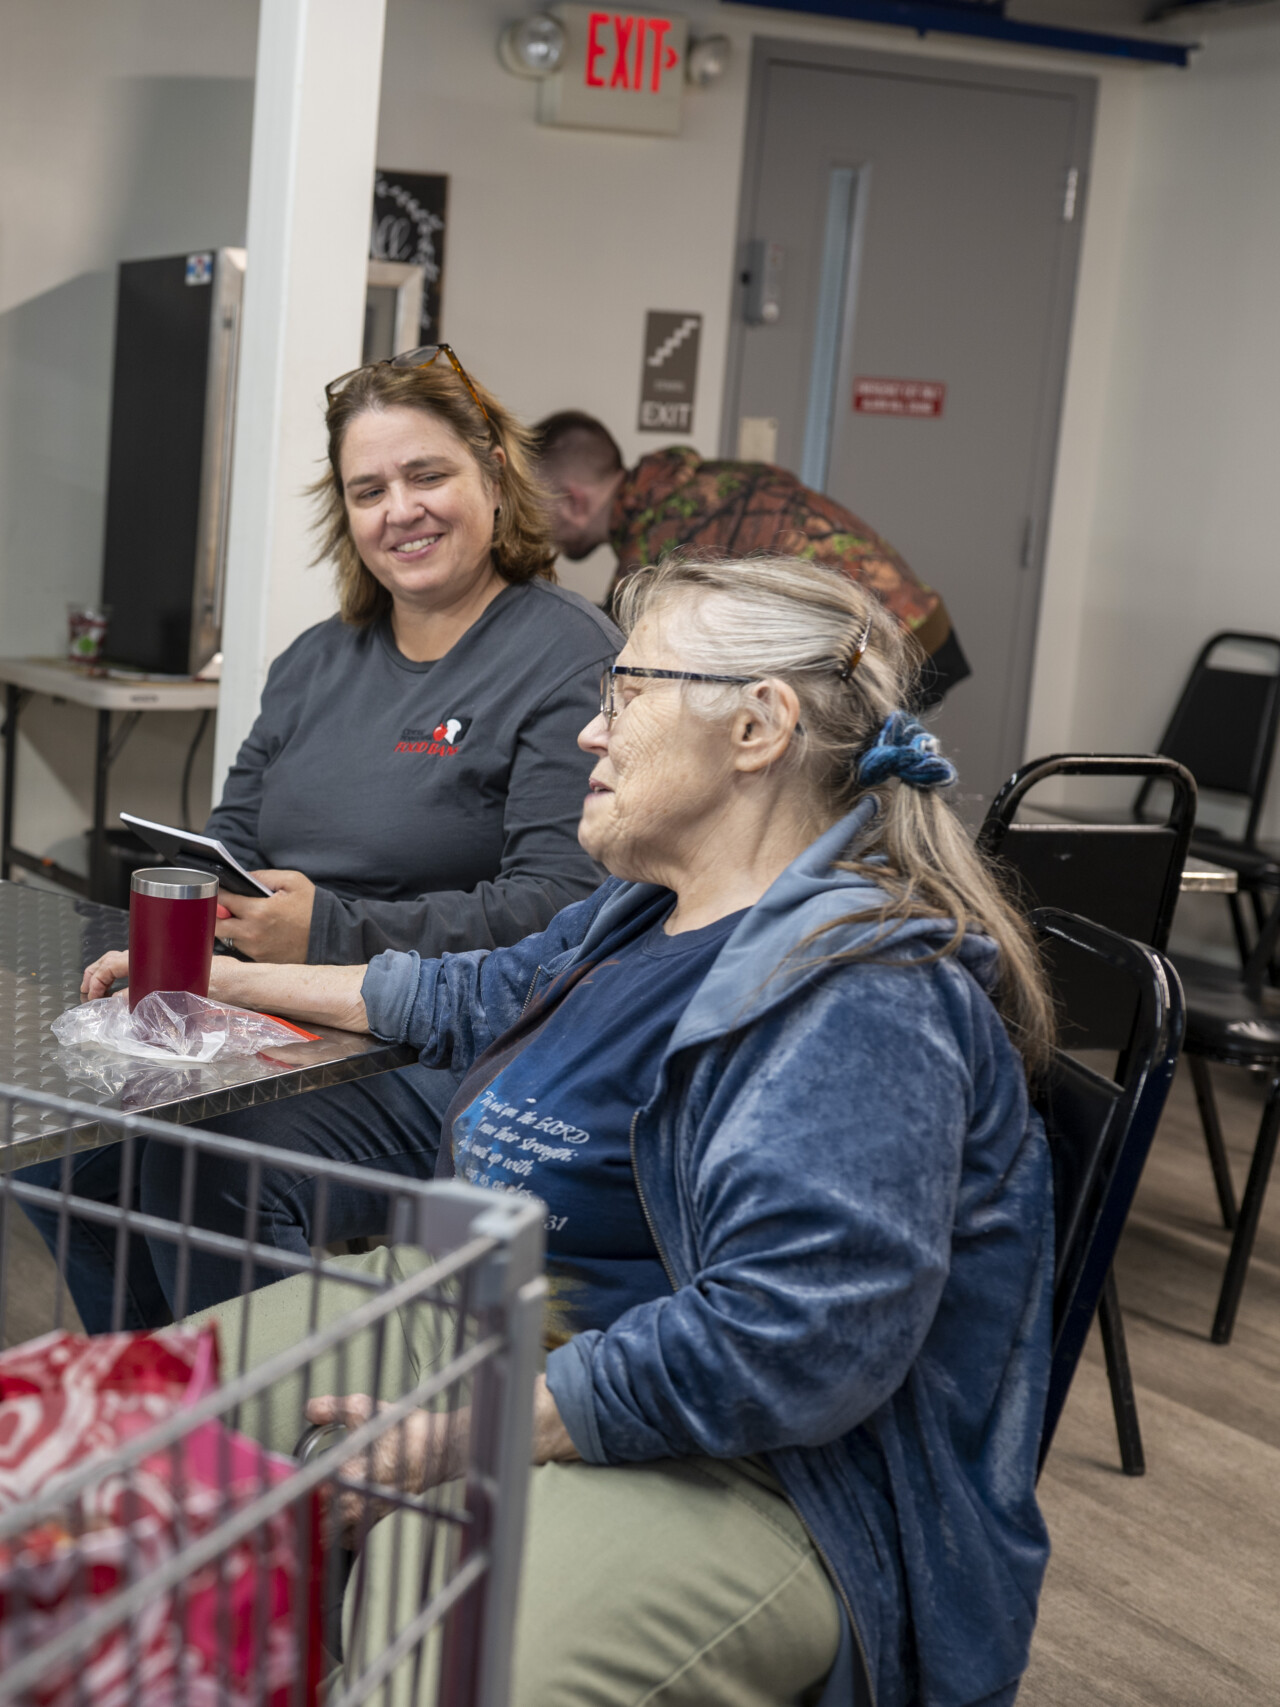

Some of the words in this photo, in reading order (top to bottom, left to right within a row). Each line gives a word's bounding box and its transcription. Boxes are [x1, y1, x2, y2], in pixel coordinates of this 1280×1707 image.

[585, 12, 672, 93] EXIT
[641, 401, 691, 428] EXIT
[394, 741, 429, 753] FOOD
[493, 1126, 521, 1143] their
[532, 1116, 590, 1144] LORD
[502, 1158, 534, 1176] with
